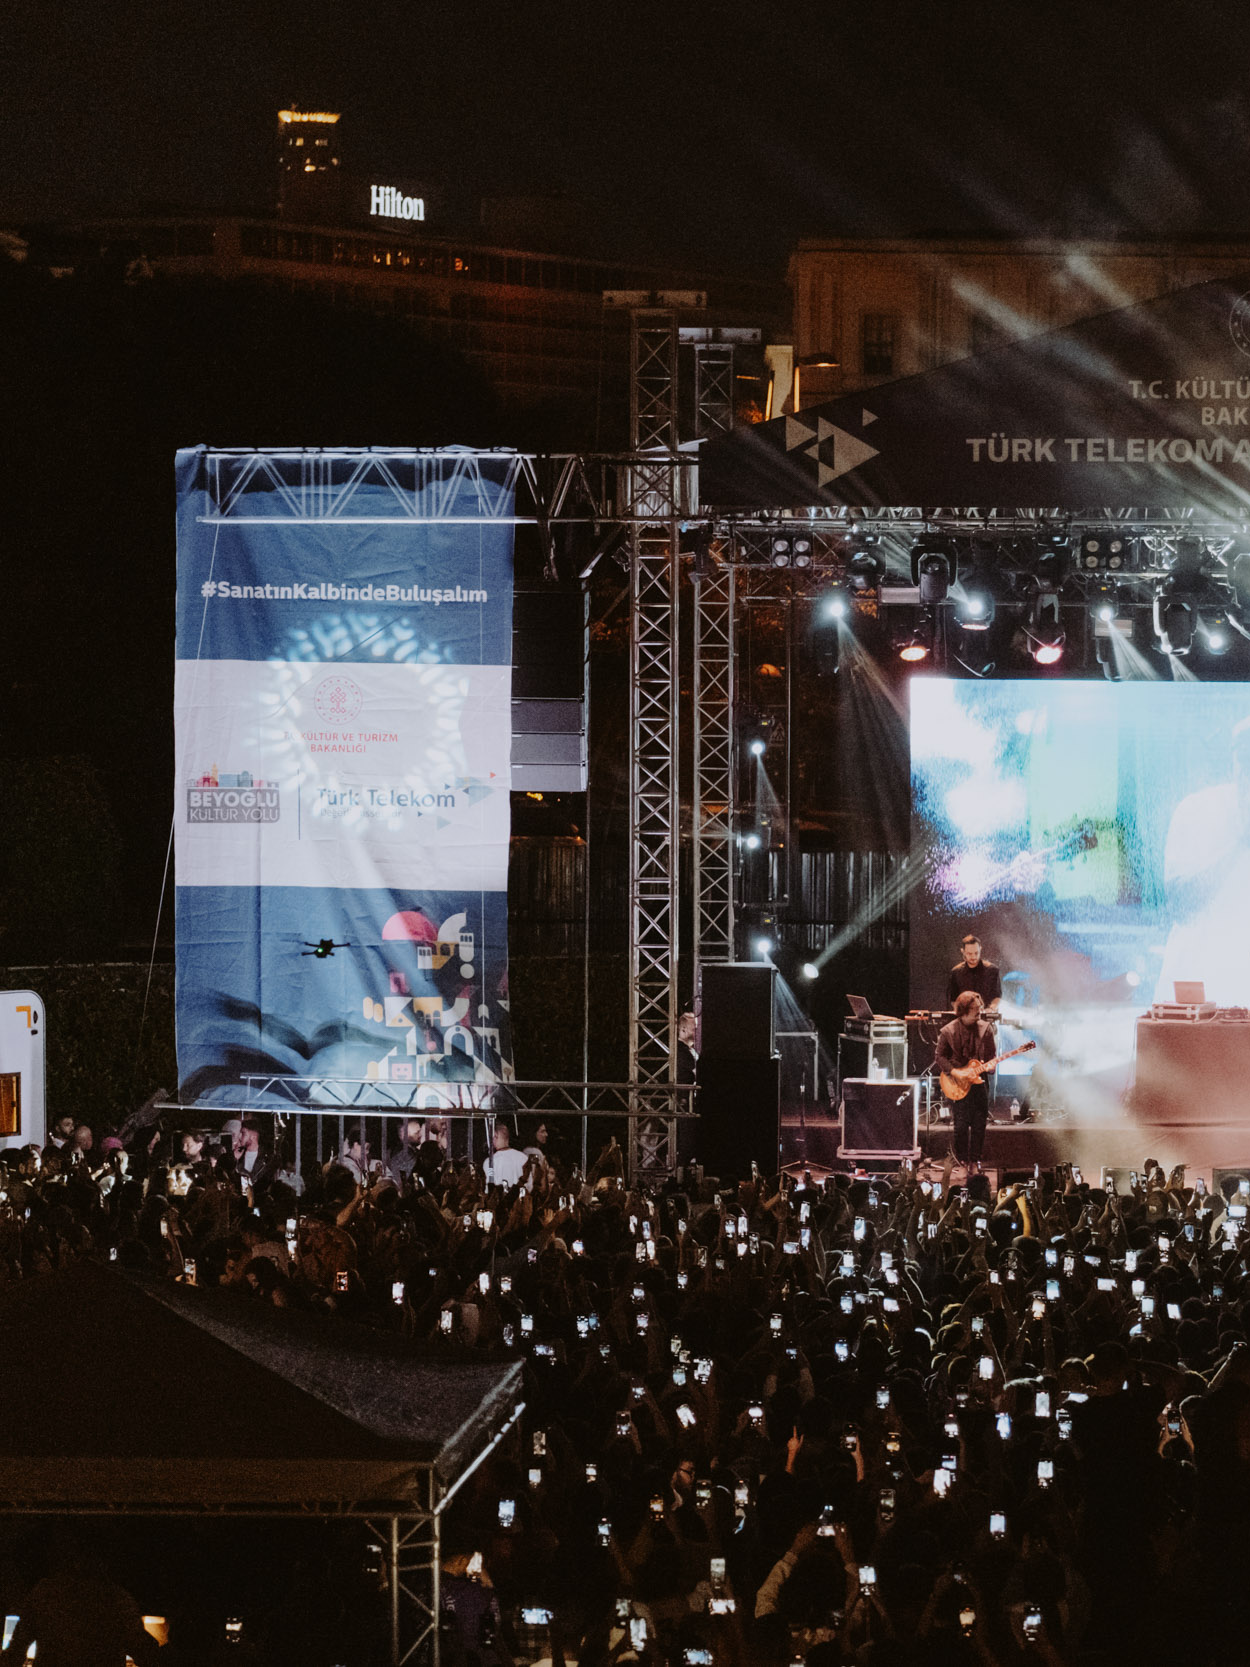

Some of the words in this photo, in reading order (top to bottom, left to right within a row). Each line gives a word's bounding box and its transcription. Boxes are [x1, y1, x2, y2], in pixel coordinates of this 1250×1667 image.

[370, 184, 425, 221] Hilton
[1128, 380, 1170, 400] T.C.
[965, 432, 1057, 463] TÜRK
[1064, 438, 1224, 463] TELEKOM
[201, 580, 488, 606] #SanatınKalbindeBuluşalım
[341, 733, 355, 742] VE
[316, 788, 360, 806] Türk
[367, 789, 456, 808] Telekom
[241, 808, 278, 821] YOLU
